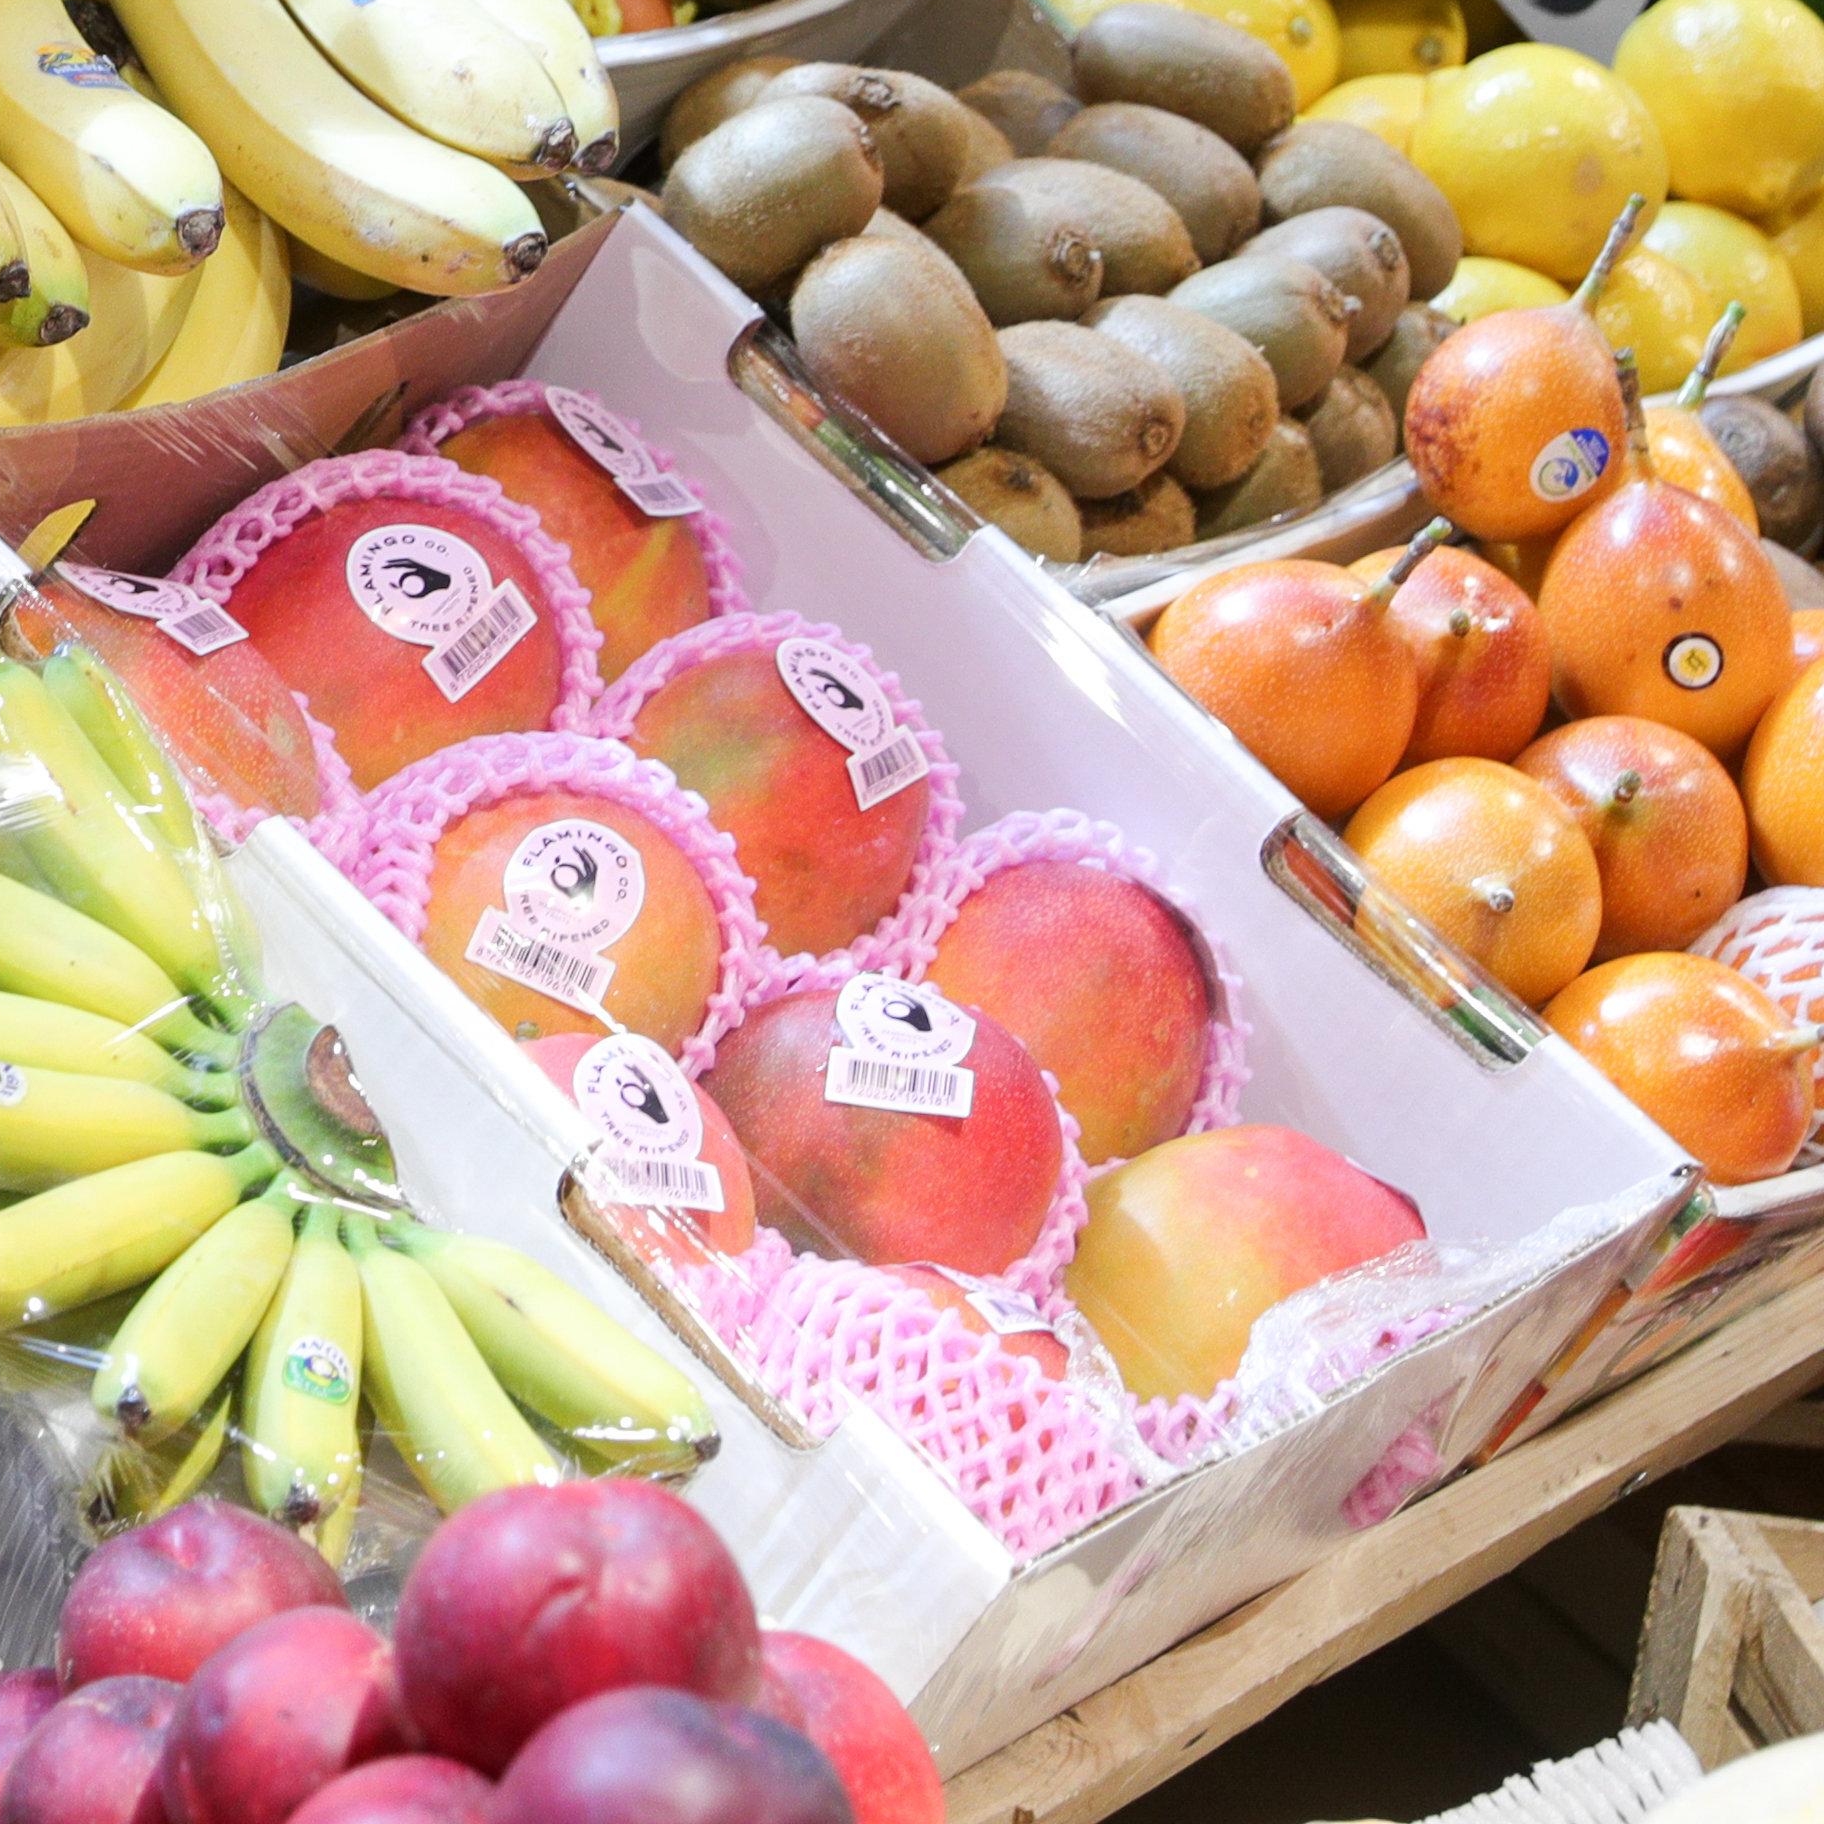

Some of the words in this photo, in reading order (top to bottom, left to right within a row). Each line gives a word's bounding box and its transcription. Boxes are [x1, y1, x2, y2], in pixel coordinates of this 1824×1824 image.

[359, 534, 415, 616] FLAMINGO
[409, 619, 452, 633] TREE
[521, 829, 628, 869] FLAMINGO
